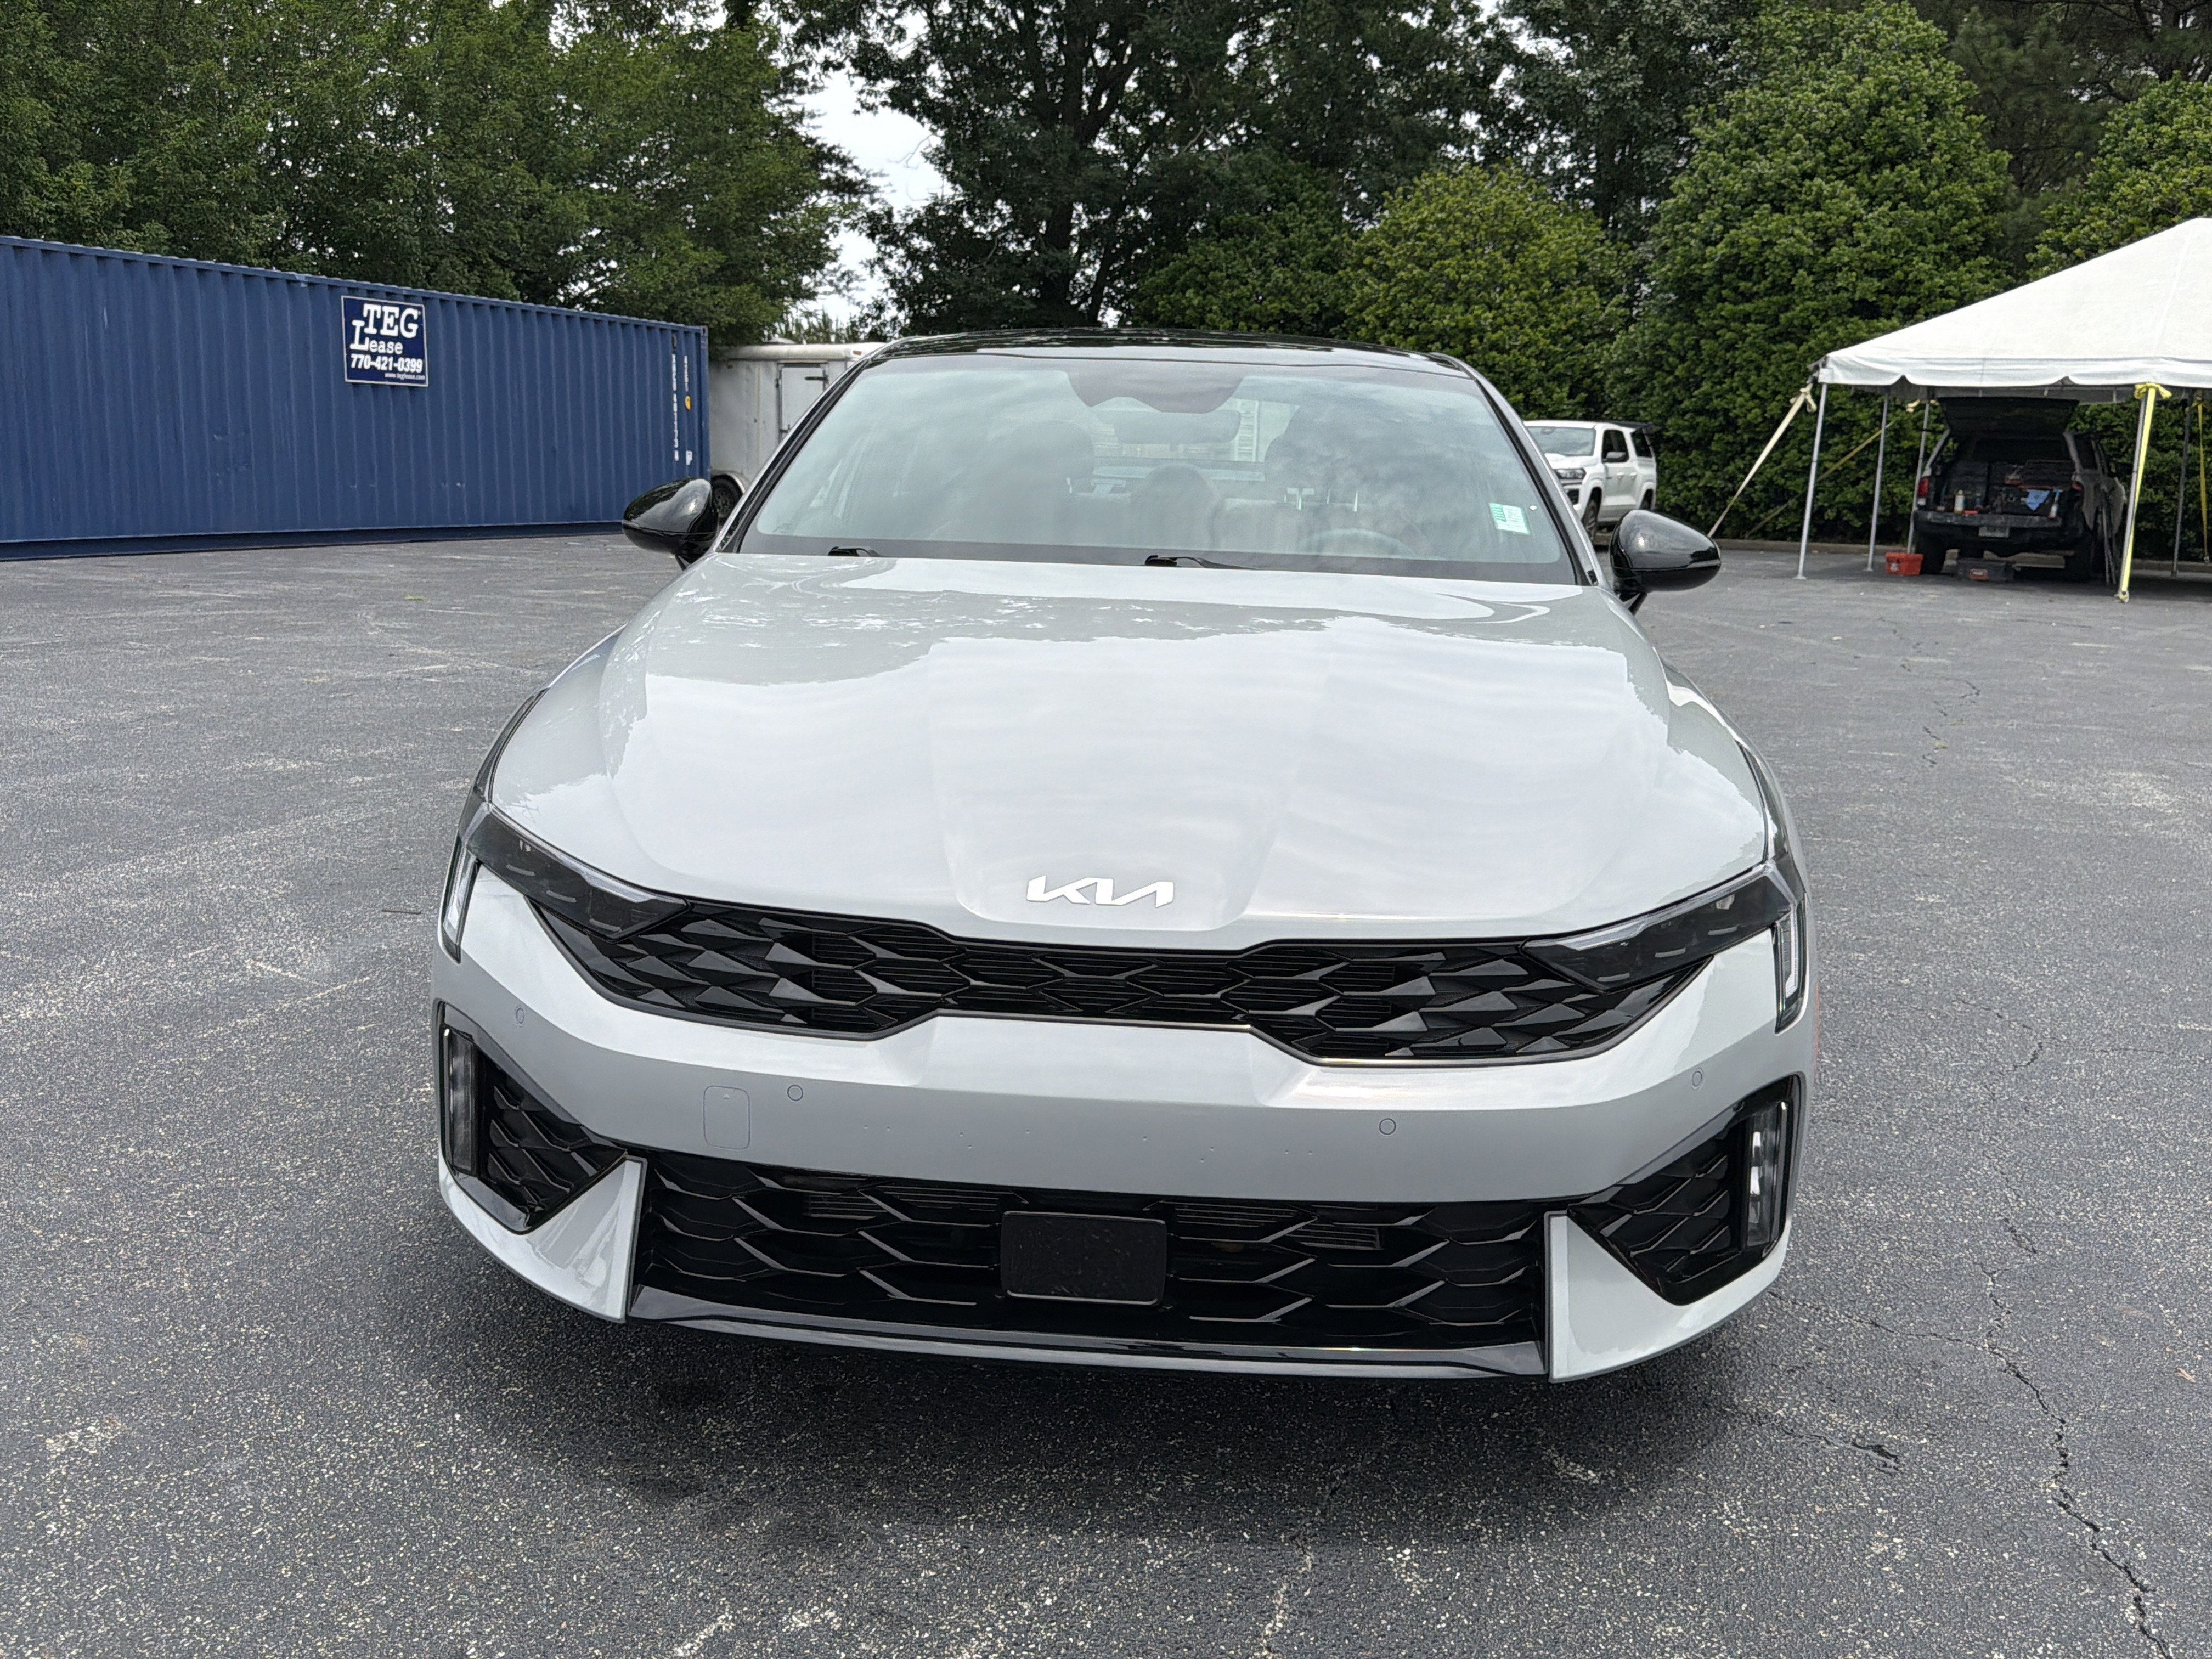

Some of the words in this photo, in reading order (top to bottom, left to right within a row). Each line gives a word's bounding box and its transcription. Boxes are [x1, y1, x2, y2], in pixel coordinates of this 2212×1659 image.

[349, 320, 403, 354] Lease
[363, 303, 419, 338] TEG
[351, 353, 423, 373] 770-421-0399
